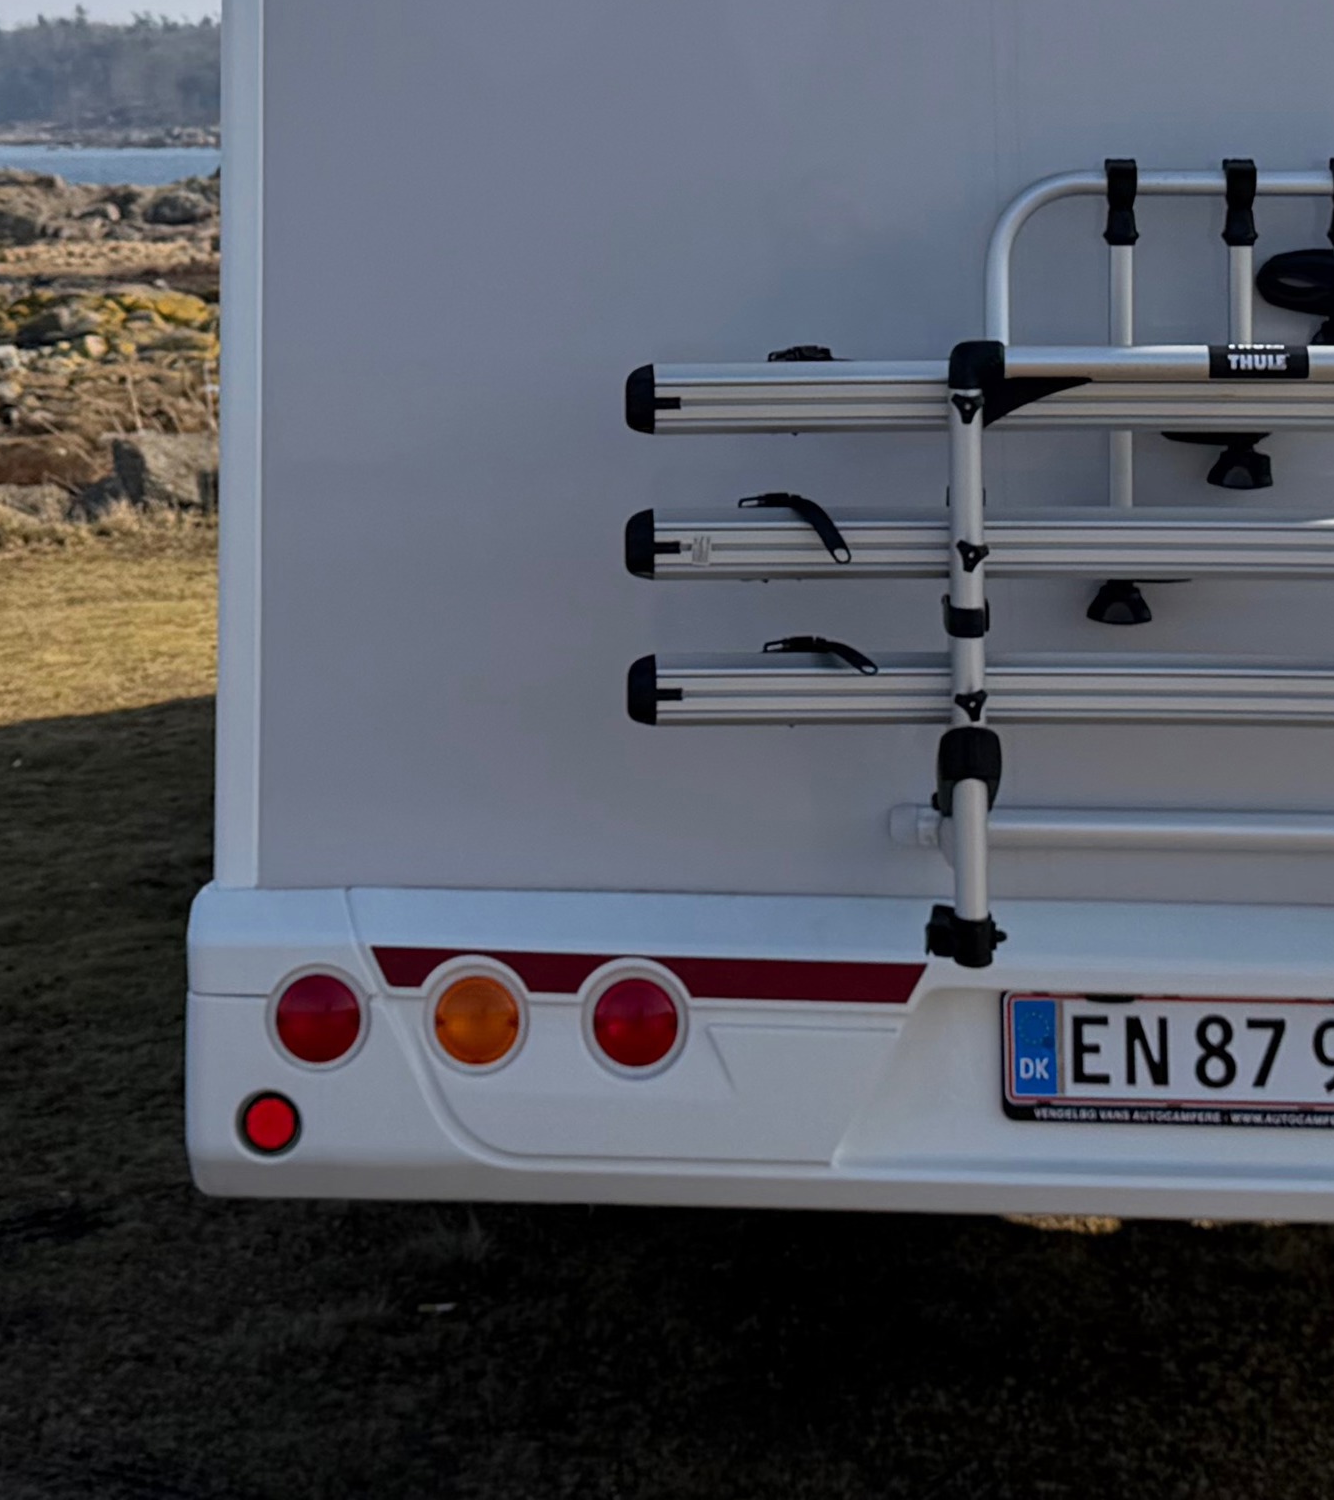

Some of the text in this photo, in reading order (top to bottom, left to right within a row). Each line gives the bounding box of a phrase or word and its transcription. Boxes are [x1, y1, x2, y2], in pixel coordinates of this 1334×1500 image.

[1227, 353, 1288, 371] THULE
[1071, 1014, 1170, 1086] EN
[1195, 1014, 1287, 1090] 87
[1018, 1057, 1050, 1081] DK
